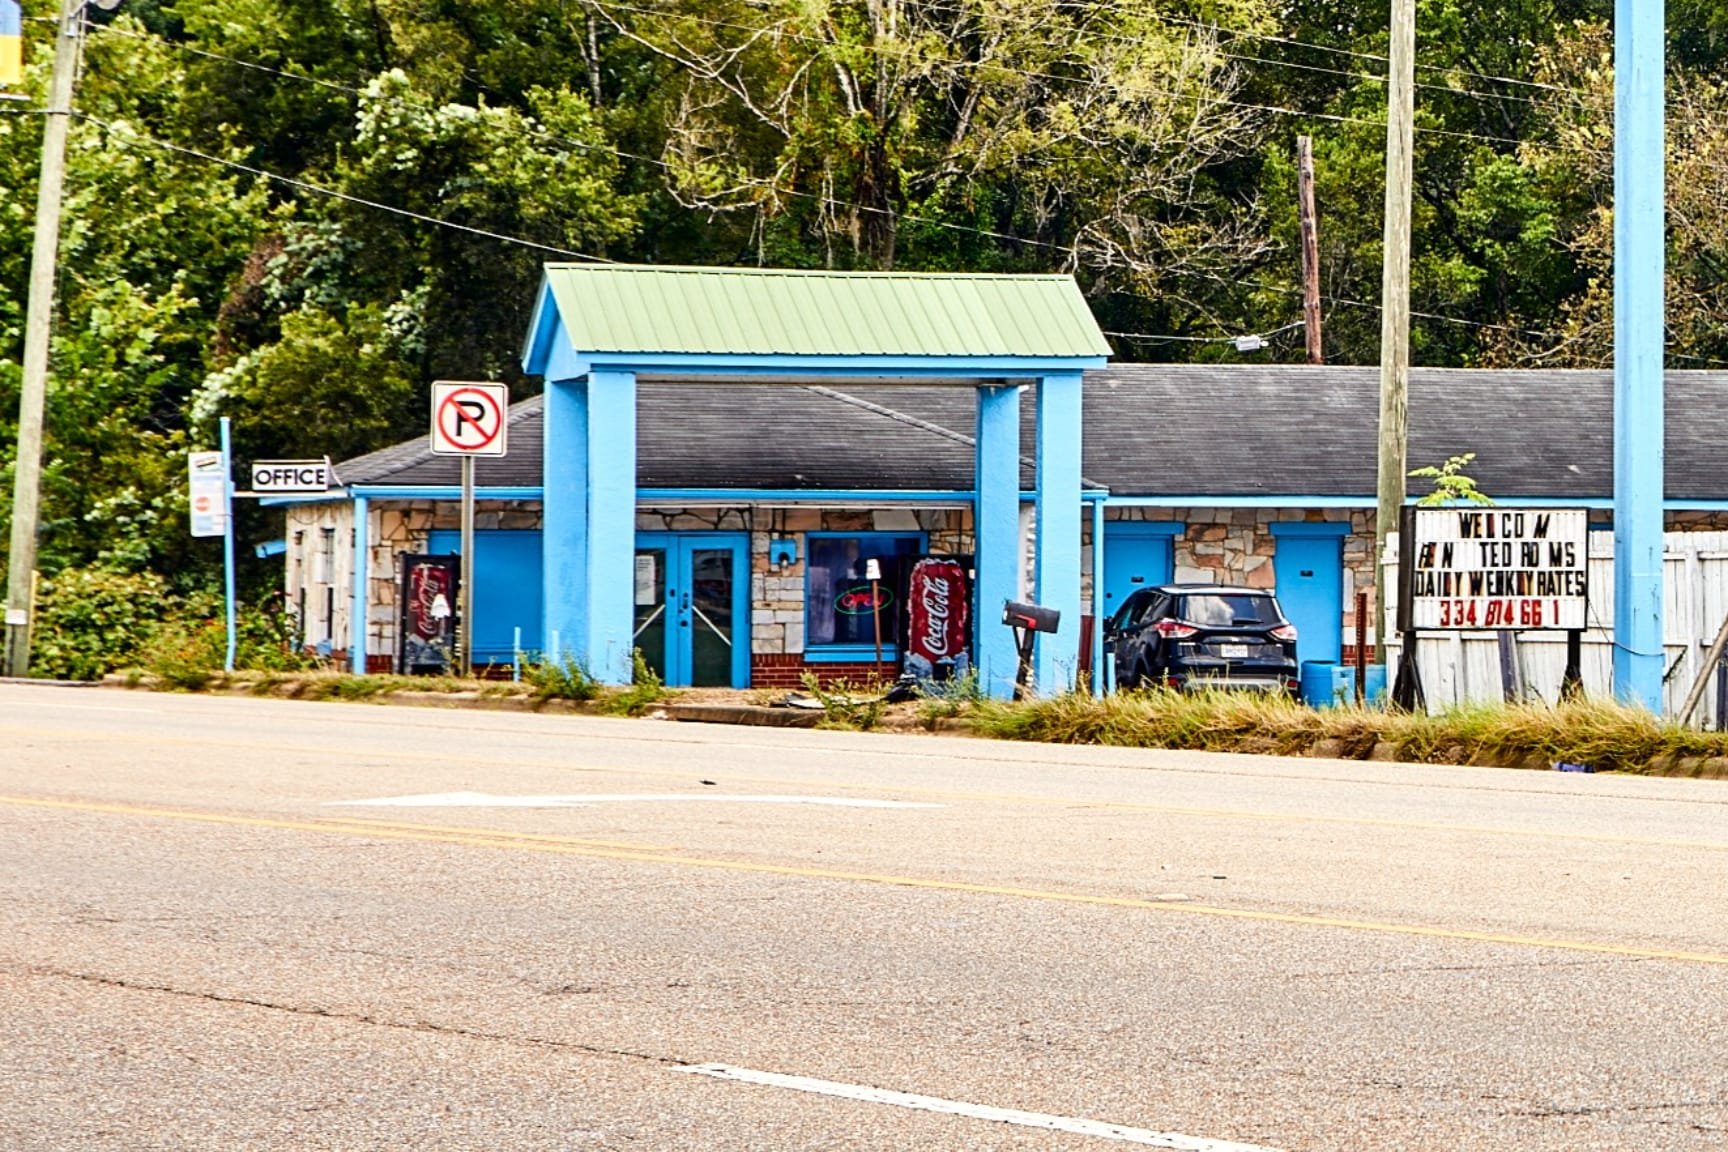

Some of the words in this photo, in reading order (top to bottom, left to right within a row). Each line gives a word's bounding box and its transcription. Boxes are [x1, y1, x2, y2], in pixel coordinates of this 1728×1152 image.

[456, 401, 485, 436] P
[255, 469, 326, 485] OFFICE
[1415, 571, 1462, 597] DAILY
[1469, 571, 1534, 597] WEEKLY
[1537, 571, 1585, 597] RATES
[1440, 600, 1477, 626] 334
